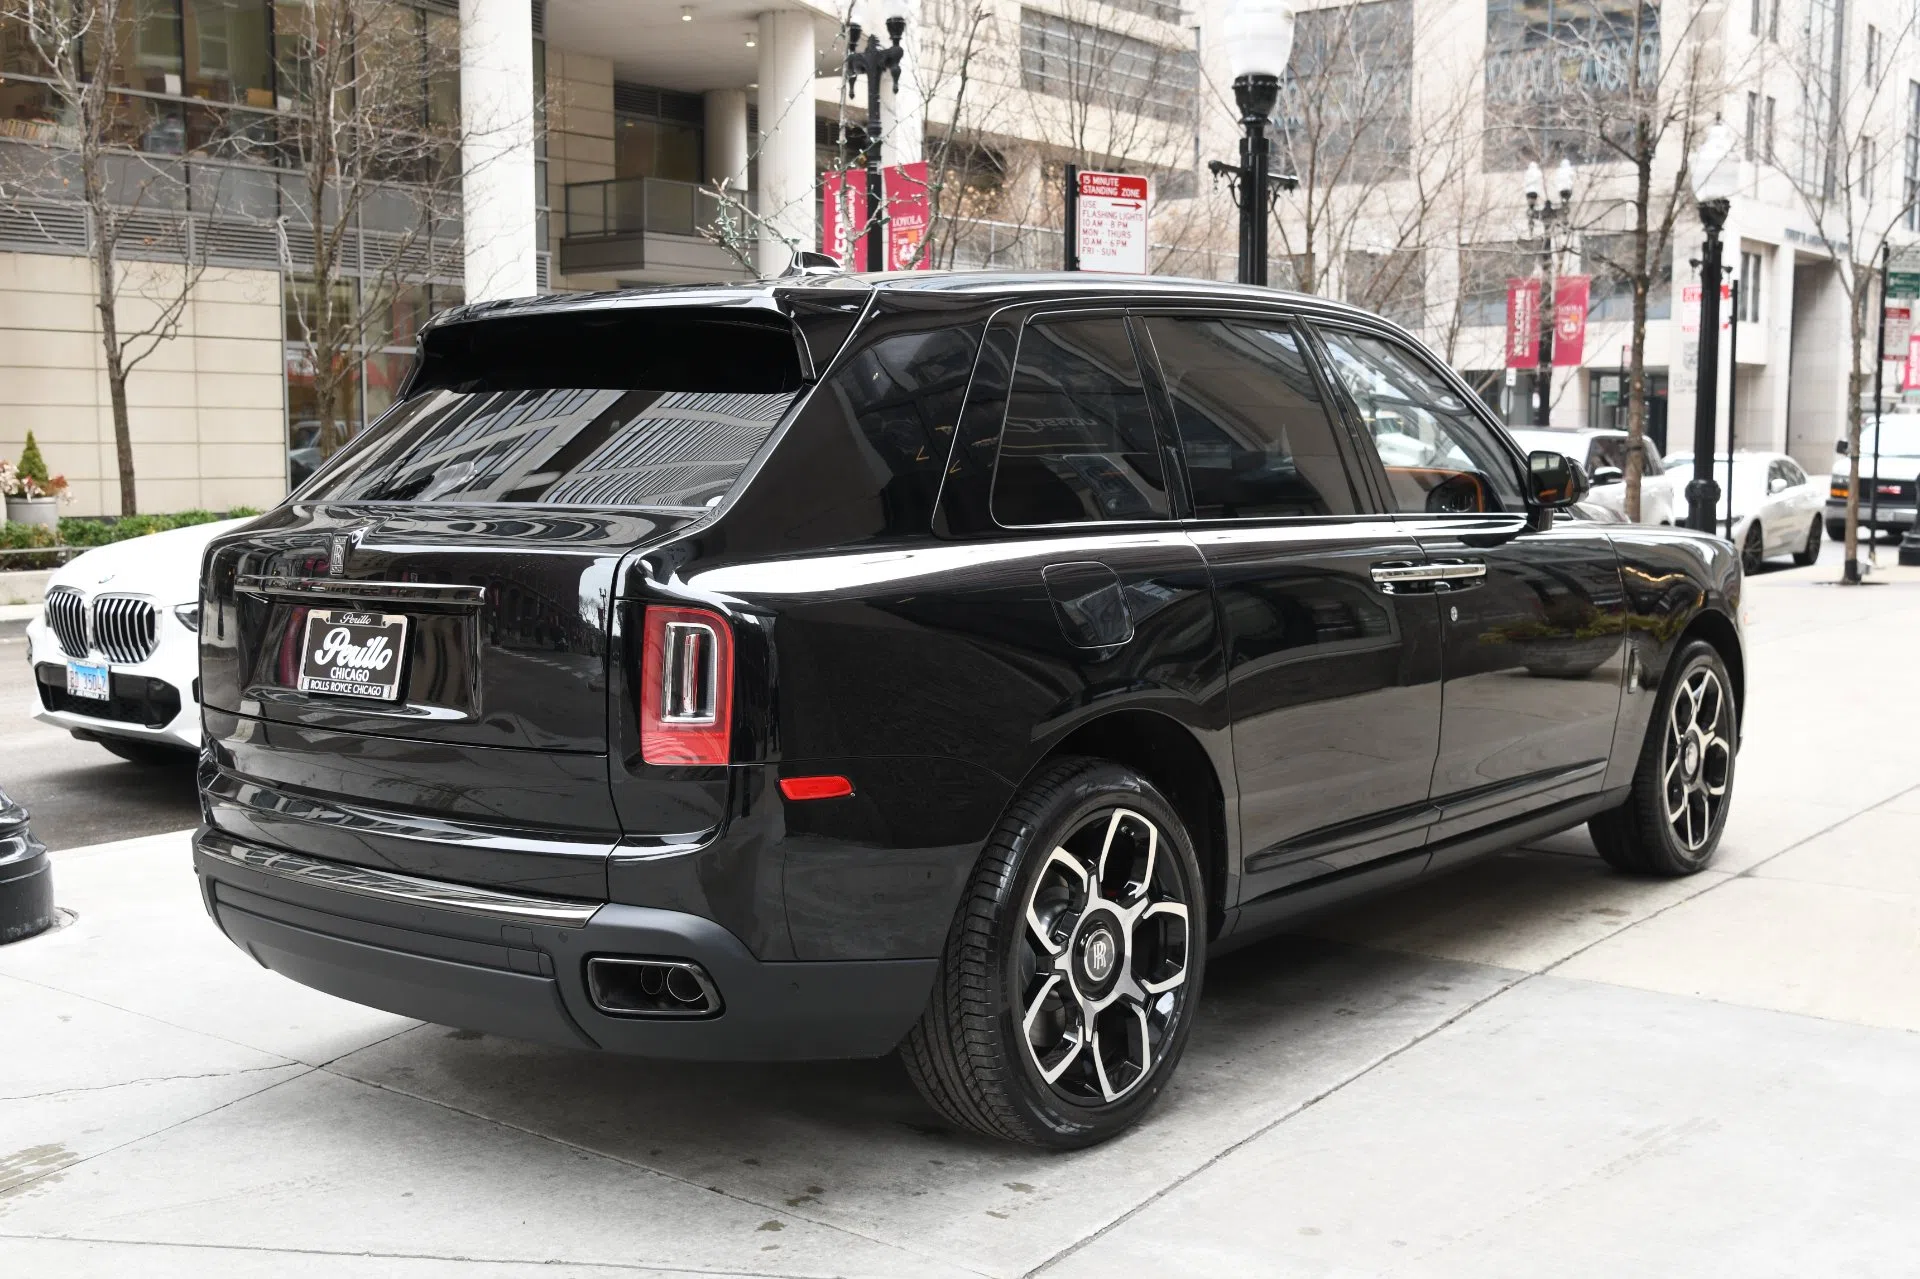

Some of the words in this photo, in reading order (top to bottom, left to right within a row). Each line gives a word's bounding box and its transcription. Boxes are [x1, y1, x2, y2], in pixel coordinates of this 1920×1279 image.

[1083, 175, 1091, 184] 15
[1092, 176, 1120, 187] MINUTE
[1083, 185, 1118, 196] STANDING
[1121, 188, 1141, 198] ZONE
[1082, 200, 1097, 208] USE
[892, 215, 922, 227] LOYOLA
[1082, 210, 1118, 219] FLASHING
[1119, 213, 1144, 222] LIGHTS
[1107, 230, 1132, 239] THURS
[1082, 247, 1095, 255] FRI
[1101, 248, 1117, 256] SUN
[340, 612, 372, 625] Perillo
[314, 627, 393, 670] Perillo
[330, 667, 370, 682] CHICAGO
[310, 680, 330, 691] ROLLS
[330, 682, 352, 693] ROYCE
[353, 684, 382, 696] CHICAGO
